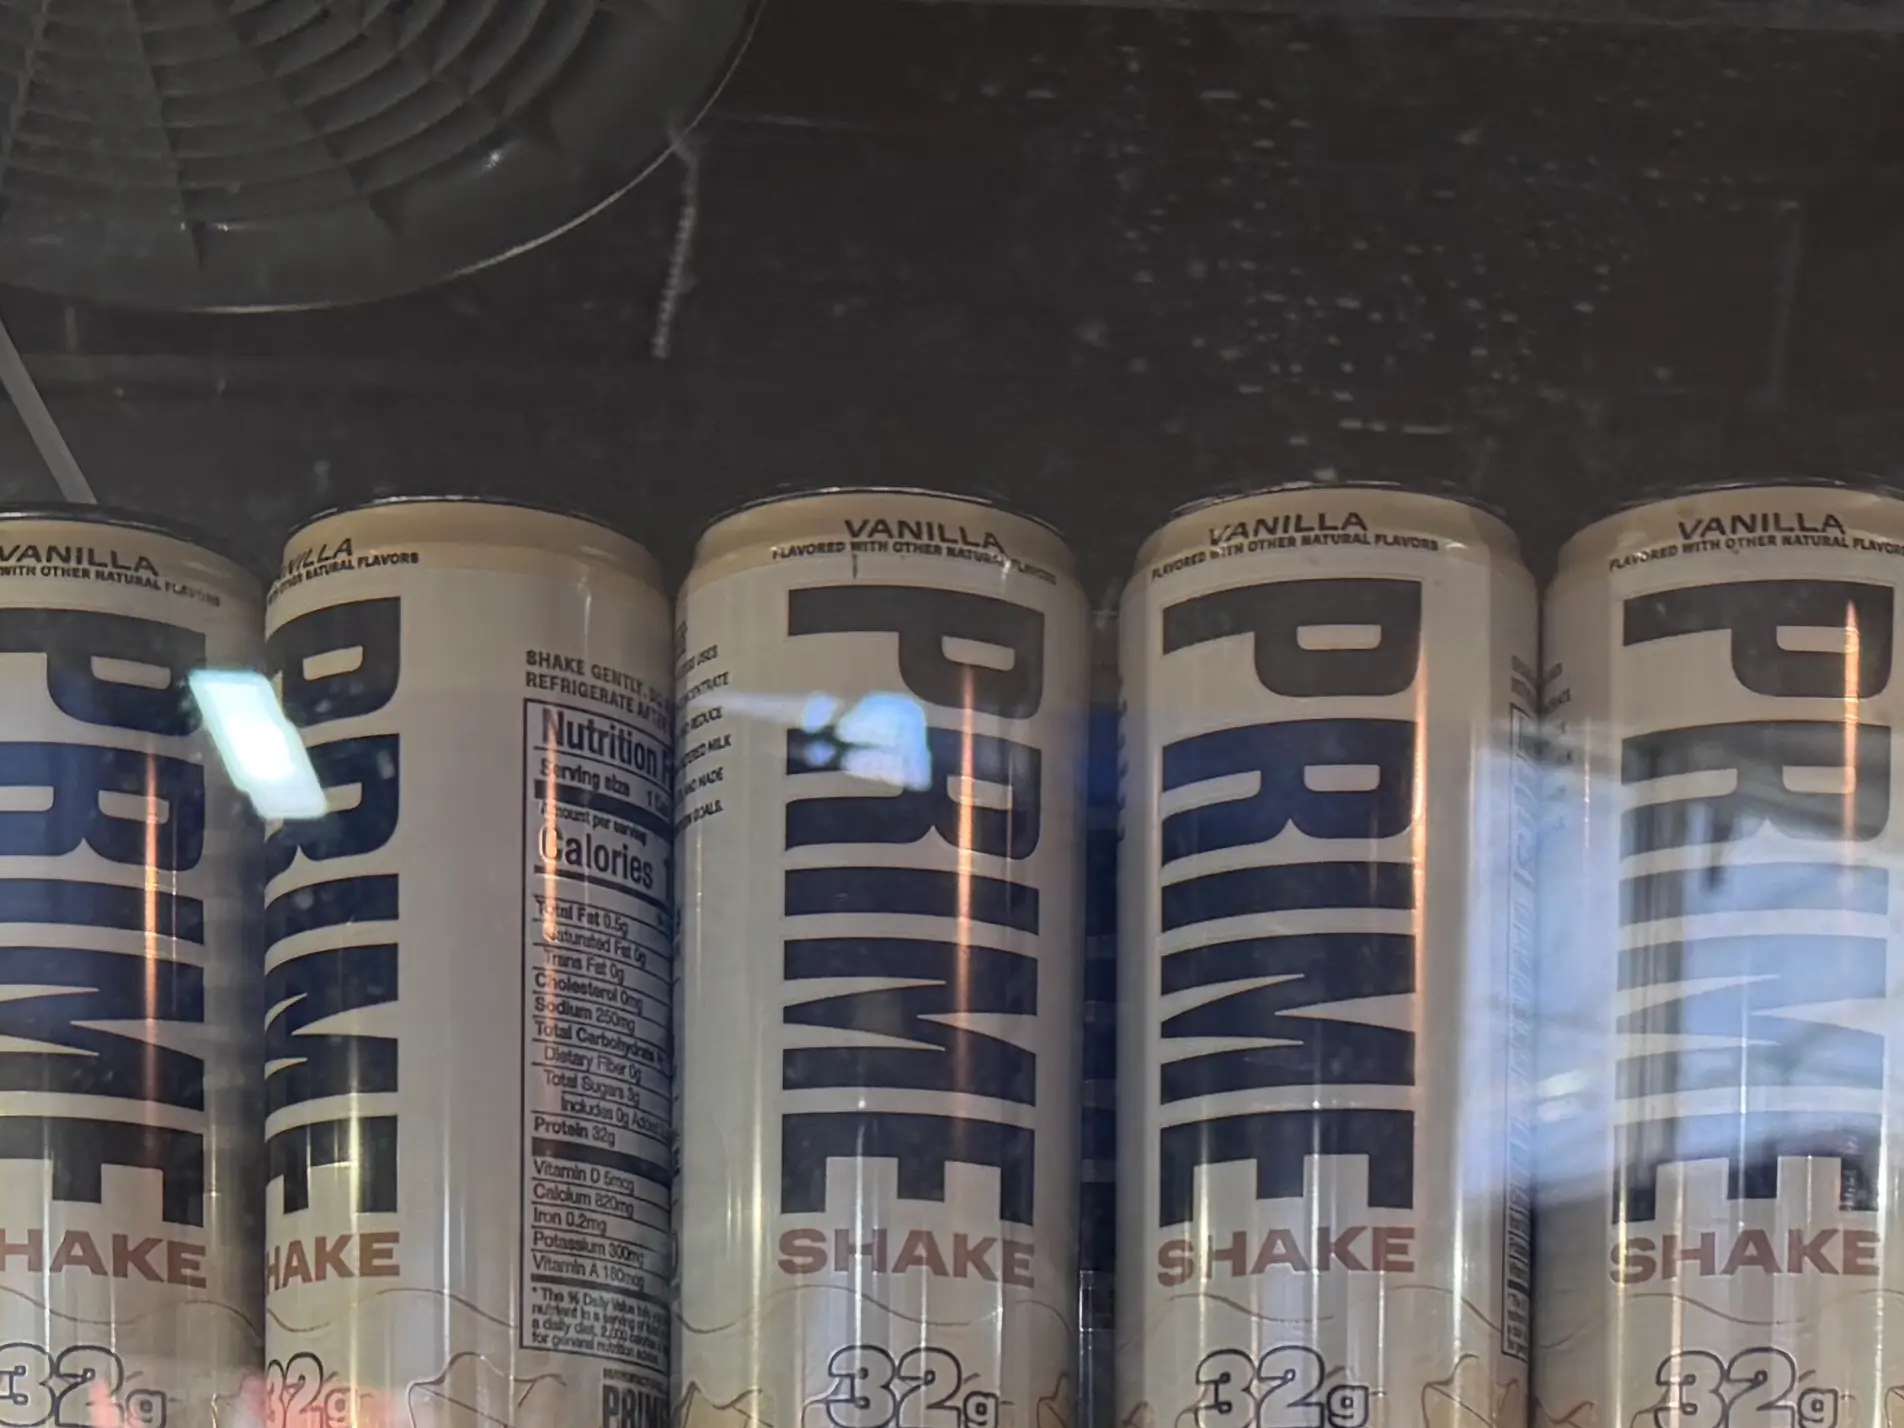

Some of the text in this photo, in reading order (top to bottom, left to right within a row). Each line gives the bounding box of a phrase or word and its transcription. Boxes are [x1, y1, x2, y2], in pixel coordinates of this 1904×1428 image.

[843, 518, 1005, 552] VANILLA
[1208, 512, 1368, 547] VANILLA
[1677, 509, 1846, 540] VANILLA
[525, 650, 586, 676] SHAKE
[525, 671, 636, 716] REFRIGERATE
[541, 708, 658, 777] Nutrition
[538, 826, 654, 889] Calories
[782, 584, 1045, 1226] PRIME
[1159, 577, 1423, 1228] PRIME
[1612, 579, 1895, 1223] PRIME
[532, 1115, 617, 1147] Protein 32g
[777, 1228, 1035, 1288] SHAKE
[1157, 1225, 1416, 1287] SHAKE
[1608, 1226, 1883, 1285] SHAKE
